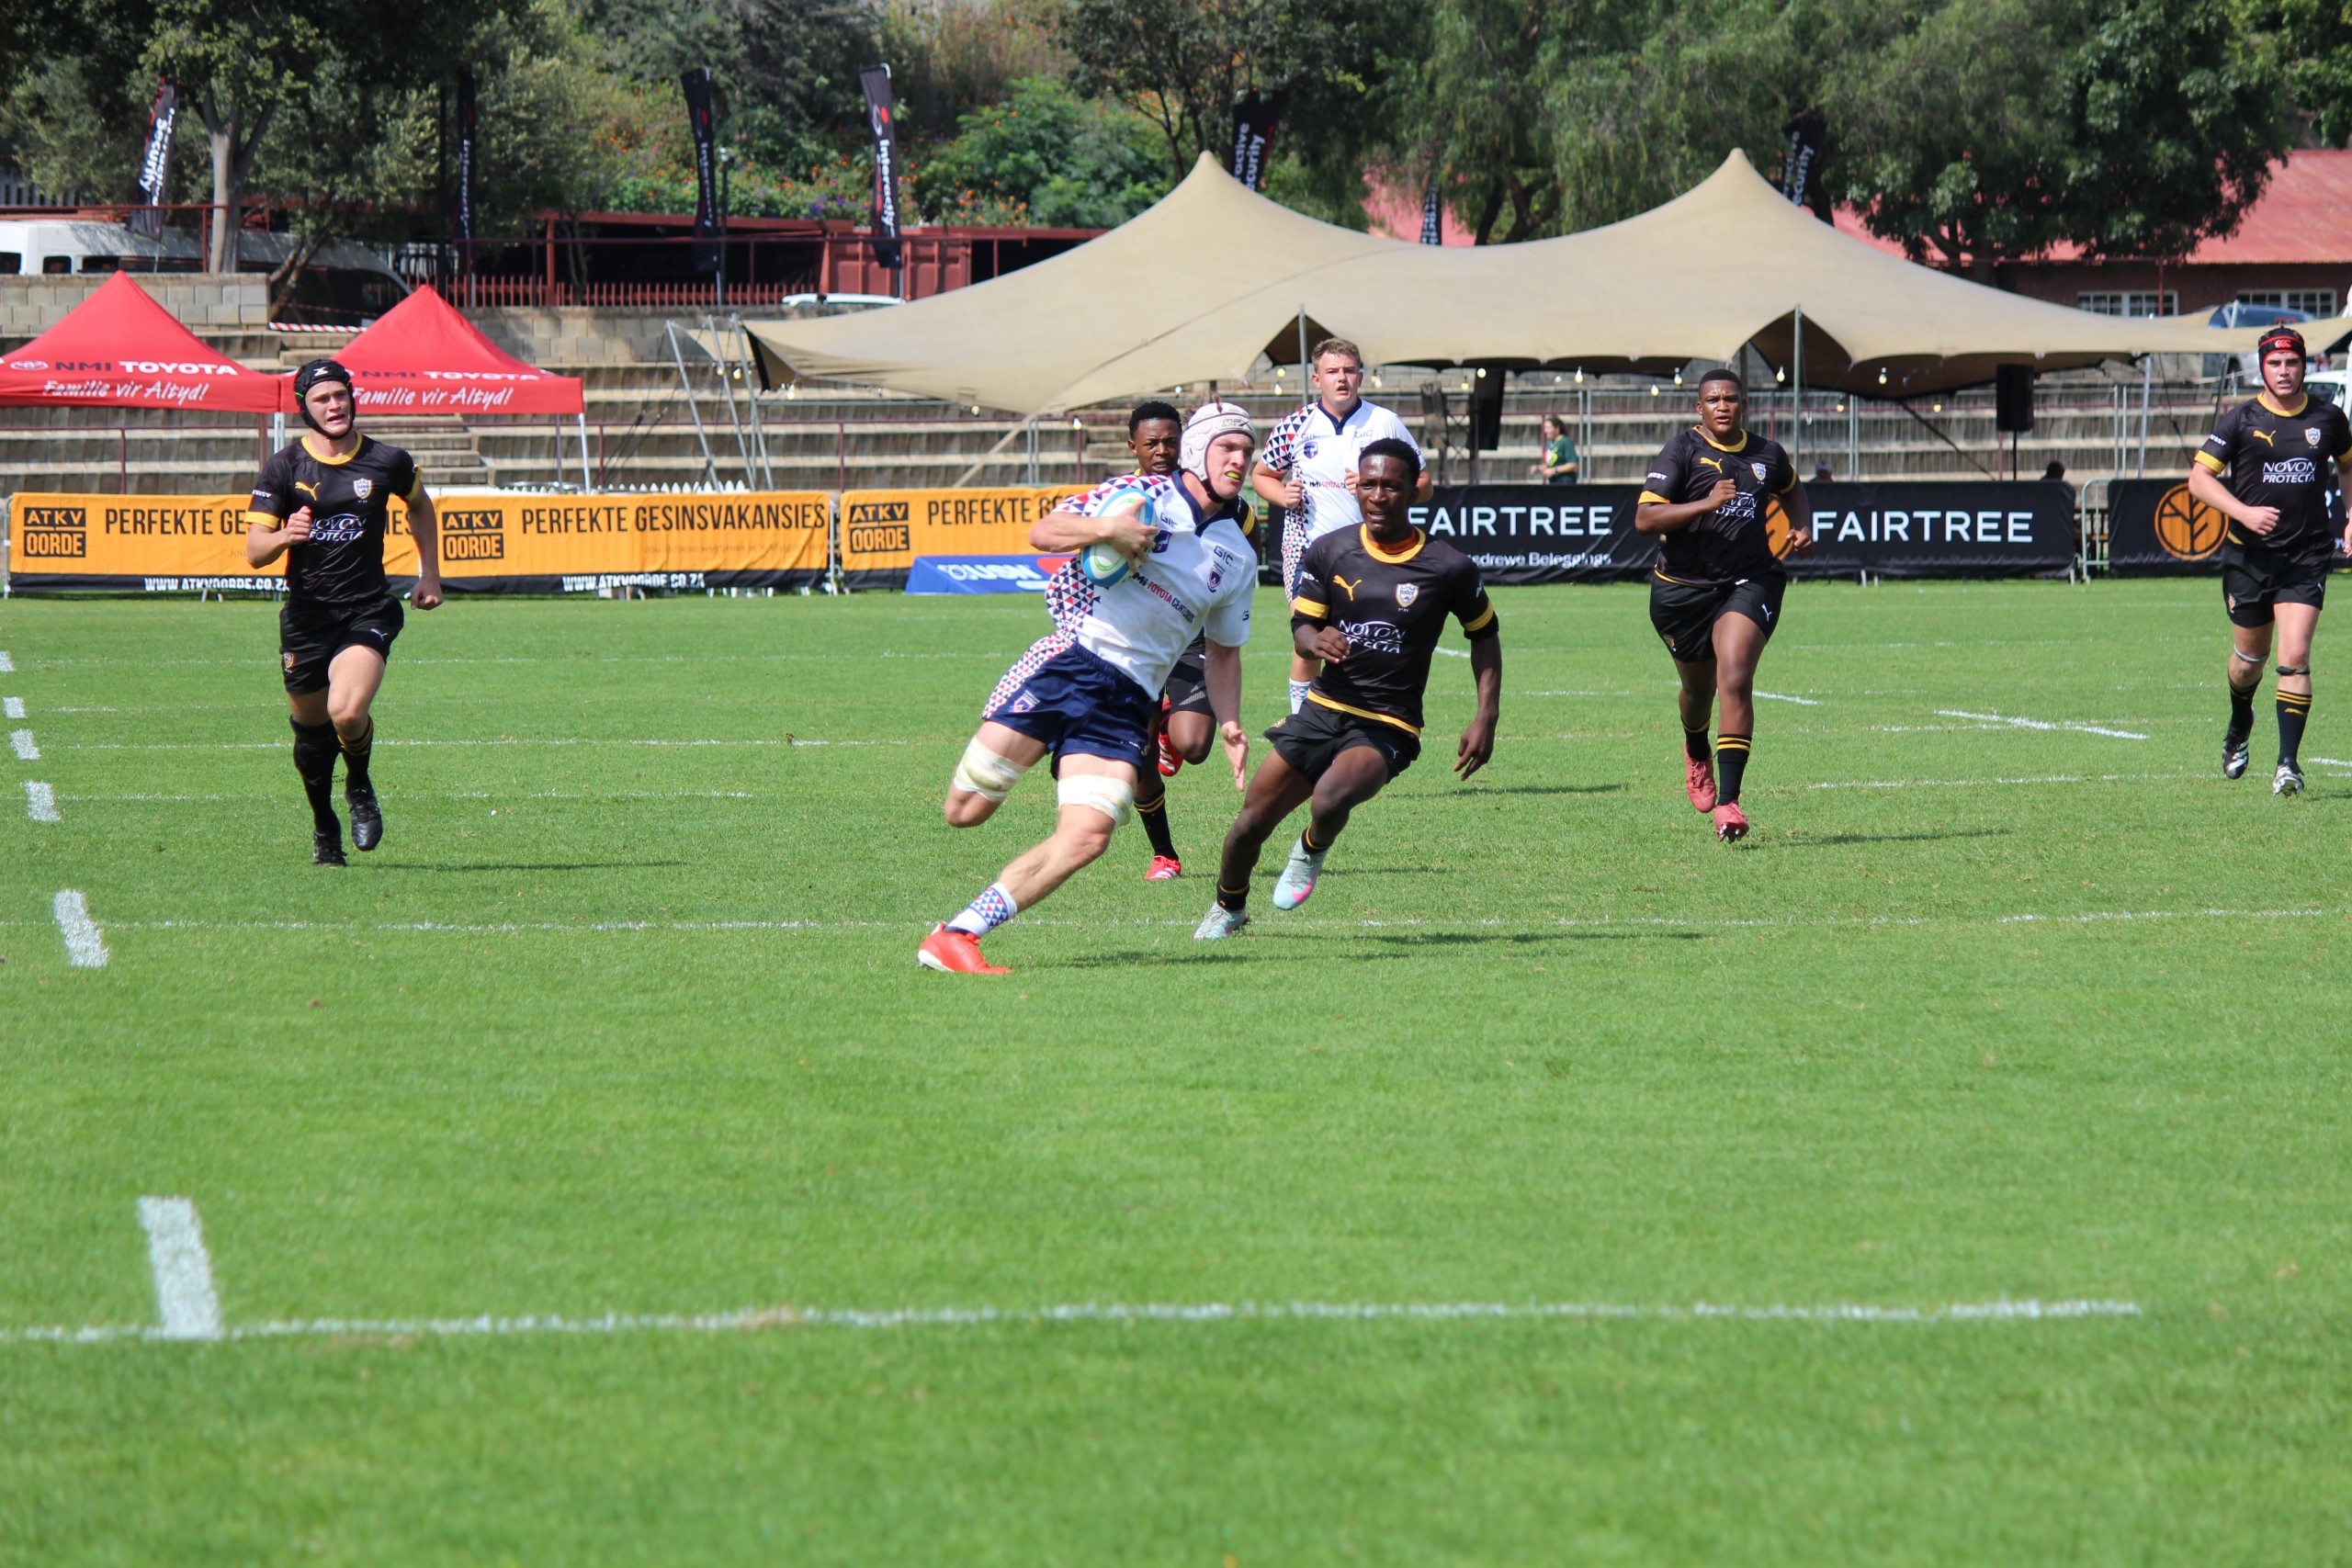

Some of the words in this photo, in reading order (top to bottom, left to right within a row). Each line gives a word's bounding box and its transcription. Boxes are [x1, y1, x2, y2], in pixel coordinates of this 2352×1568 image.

[140, 118, 167, 192] Security
[55, 361, 111, 371] NMI
[119, 360, 238, 376] TOYOTA
[424, 370, 540, 380] TOYOTA
[43, 379, 108, 398] Familie
[117, 380, 141, 399] vir
[144, 380, 209, 406] Altyd!
[353, 387, 415, 406] Familie
[422, 389, 449, 406] vir
[450, 387, 514, 412] Altyd!
[2263, 461, 2317, 473] NOVON
[2263, 473, 2315, 483] PROTECTA
[27, 510, 84, 525] ATKV
[106, 508, 213, 536] PERFEKTE
[445, 513, 501, 529] ATKV
[523, 507, 628, 534] PERFEKTE
[635, 503, 825, 532] GESINSVAKANSIES
[851, 505, 907, 523] ATKV
[928, 498, 1032, 525] PERFEKTE
[1408, 506, 1613, 536] FAIRTREE
[1812, 511, 2033, 543] FAIRTREE
[26, 532, 84, 556] OORDE
[446, 535, 502, 558] OORDE
[851, 527, 909, 551] OORDE
[1467, 551, 1525, 566] edrewe
[1148, 581, 1172, 604] TOYOTA
[1340, 619, 1407, 640] NOVON
